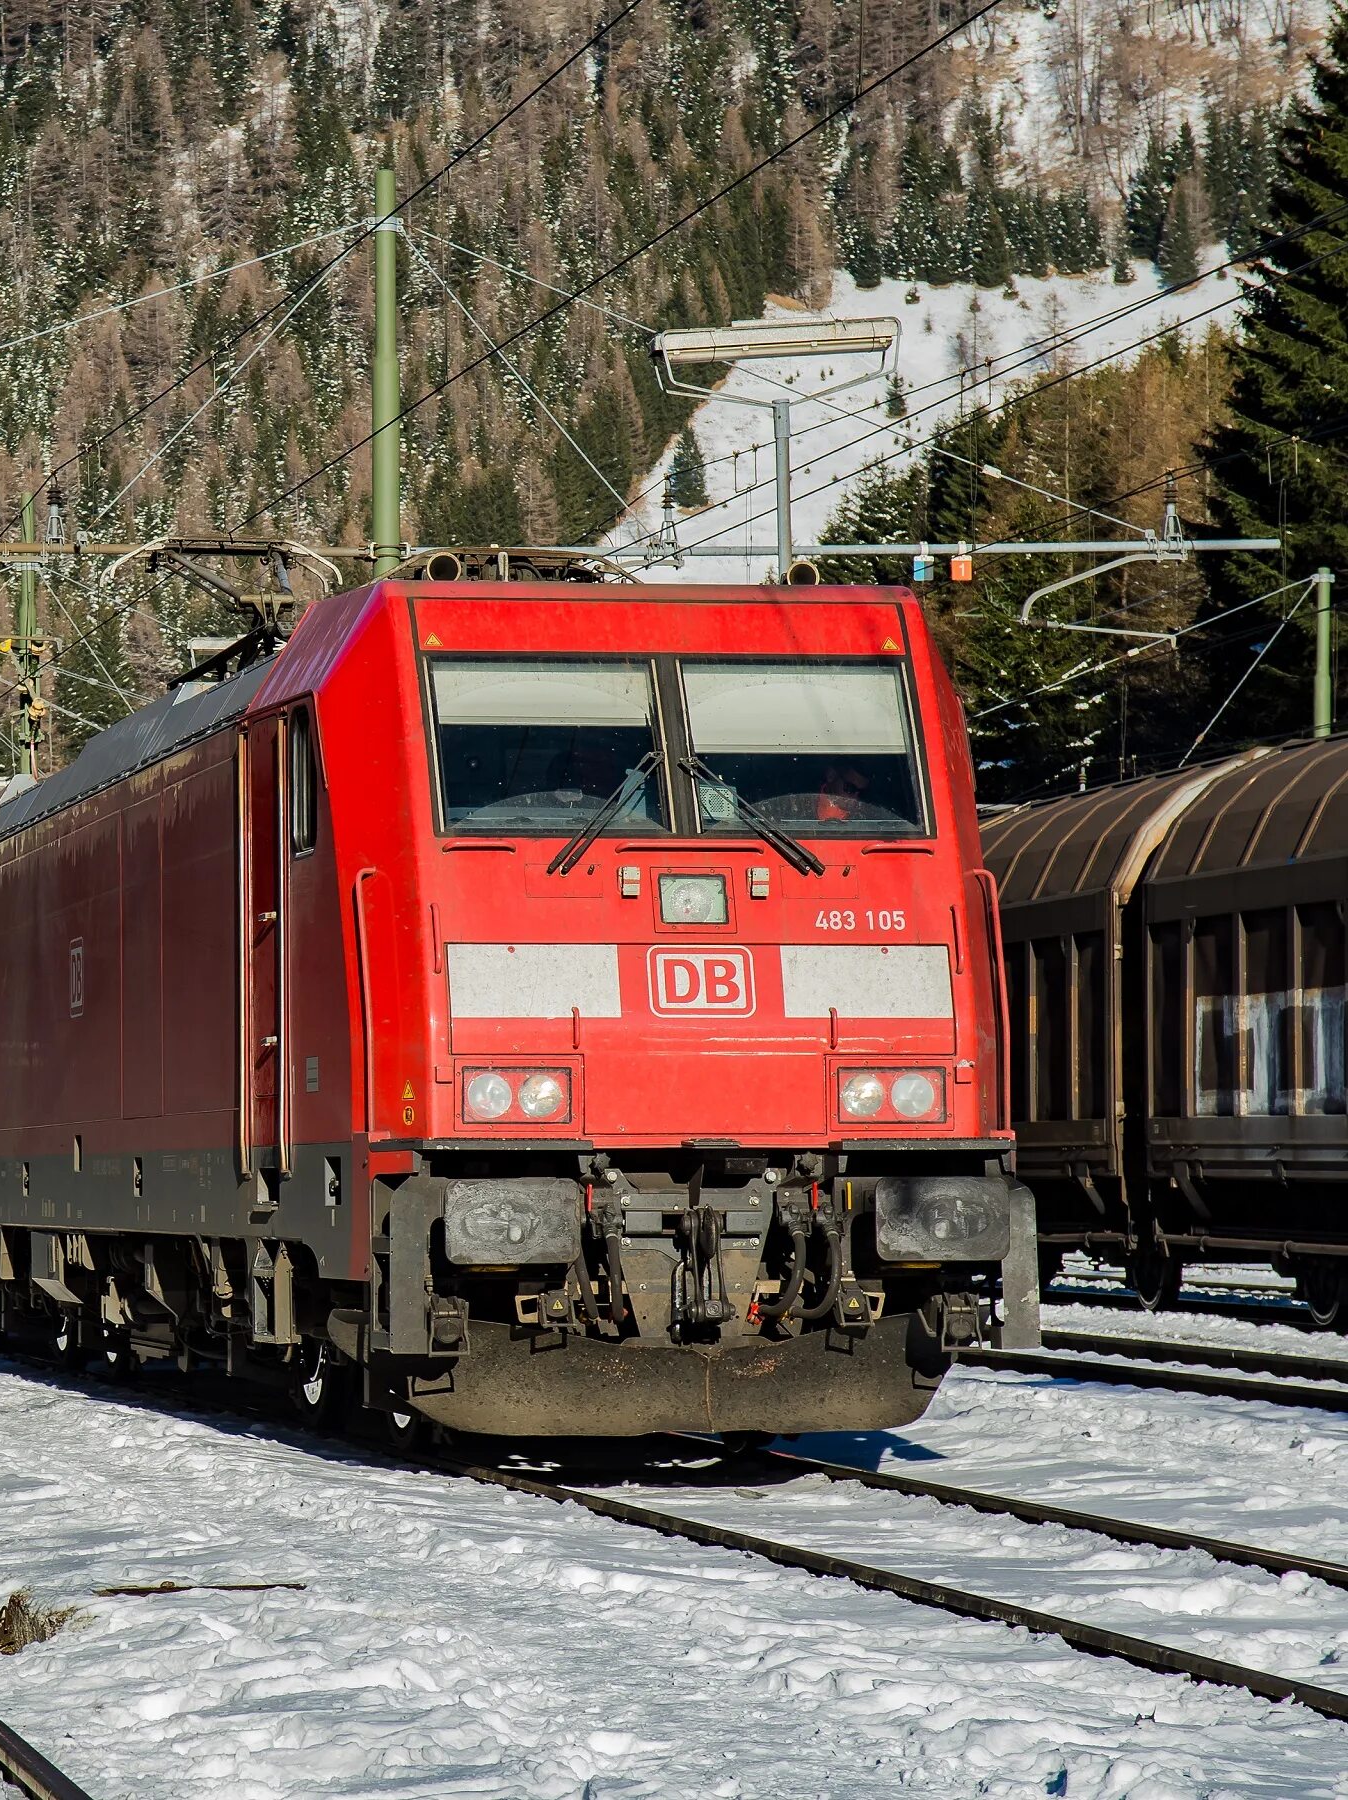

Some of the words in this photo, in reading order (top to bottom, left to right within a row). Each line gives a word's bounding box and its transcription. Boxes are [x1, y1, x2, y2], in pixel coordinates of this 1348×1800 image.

[959, 563, 964, 576] 1
[815, 909, 855, 931] 483
[864, 909, 906, 931] 105
[71, 952, 82, 1003] DB
[663, 957, 740, 1005] DB
